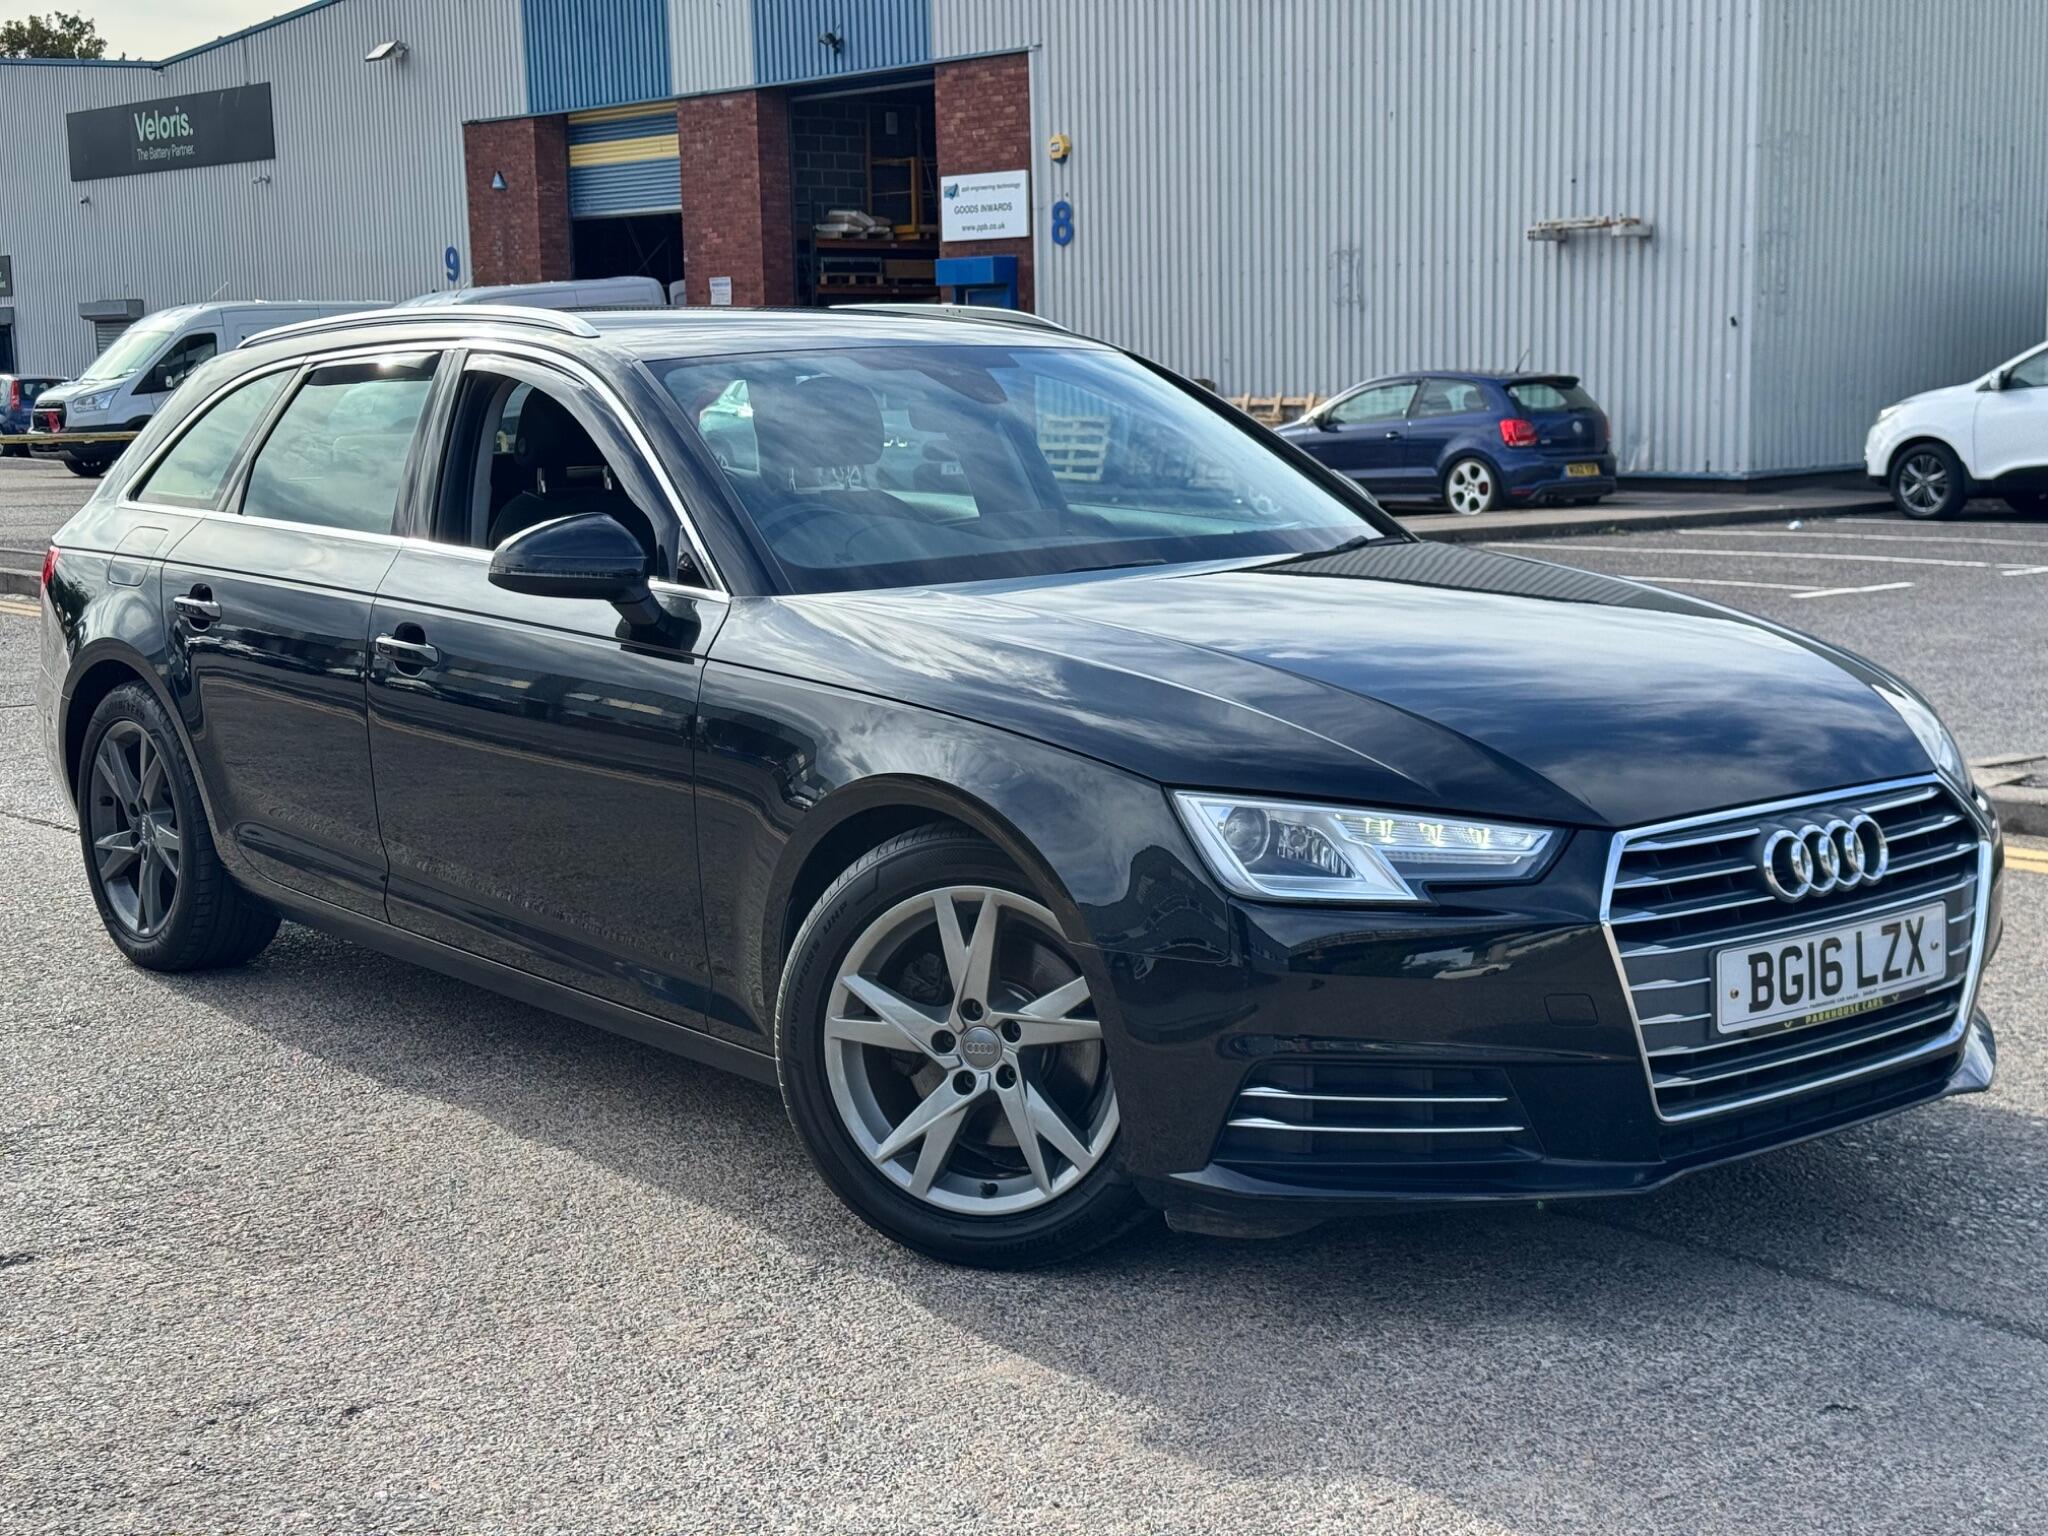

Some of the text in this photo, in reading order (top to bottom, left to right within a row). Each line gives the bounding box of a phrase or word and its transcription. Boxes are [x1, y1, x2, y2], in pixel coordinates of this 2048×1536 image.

[134, 106, 194, 141] Veloris.
[137, 148, 149, 160] The
[149, 146, 171, 160] Battery
[954, 202, 1013, 215] GOODS INWARDS
[1052, 200, 1073, 246] 8
[445, 246, 460, 281] 9
[1748, 916, 1925, 1013] BG16 LZX
[1805, 997, 1883, 1024] PARKHOUSE CARS
